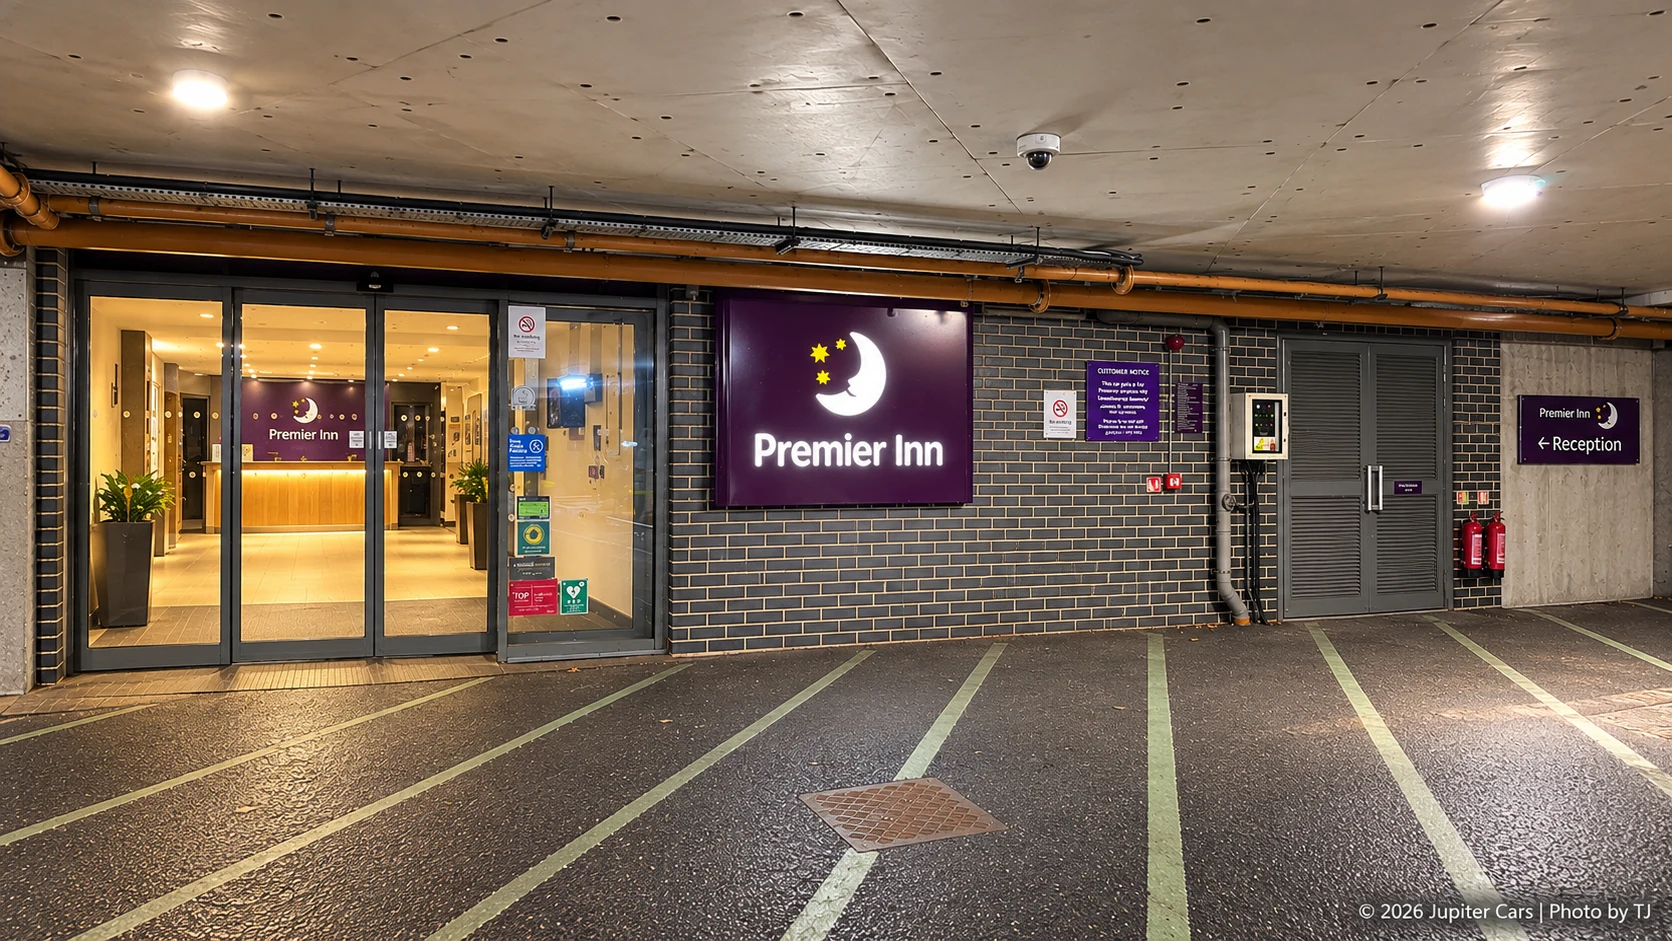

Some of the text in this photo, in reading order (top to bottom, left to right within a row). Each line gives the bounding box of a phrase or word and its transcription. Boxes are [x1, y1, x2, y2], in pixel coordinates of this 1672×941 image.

[1539, 407, 1591, 419] Premier Inn
[269, 428, 317, 441] Premier
[319, 429, 339, 441] Inn
[754, 432, 944, 468] Premier Inn
[1552, 436, 1622, 455] Reception
